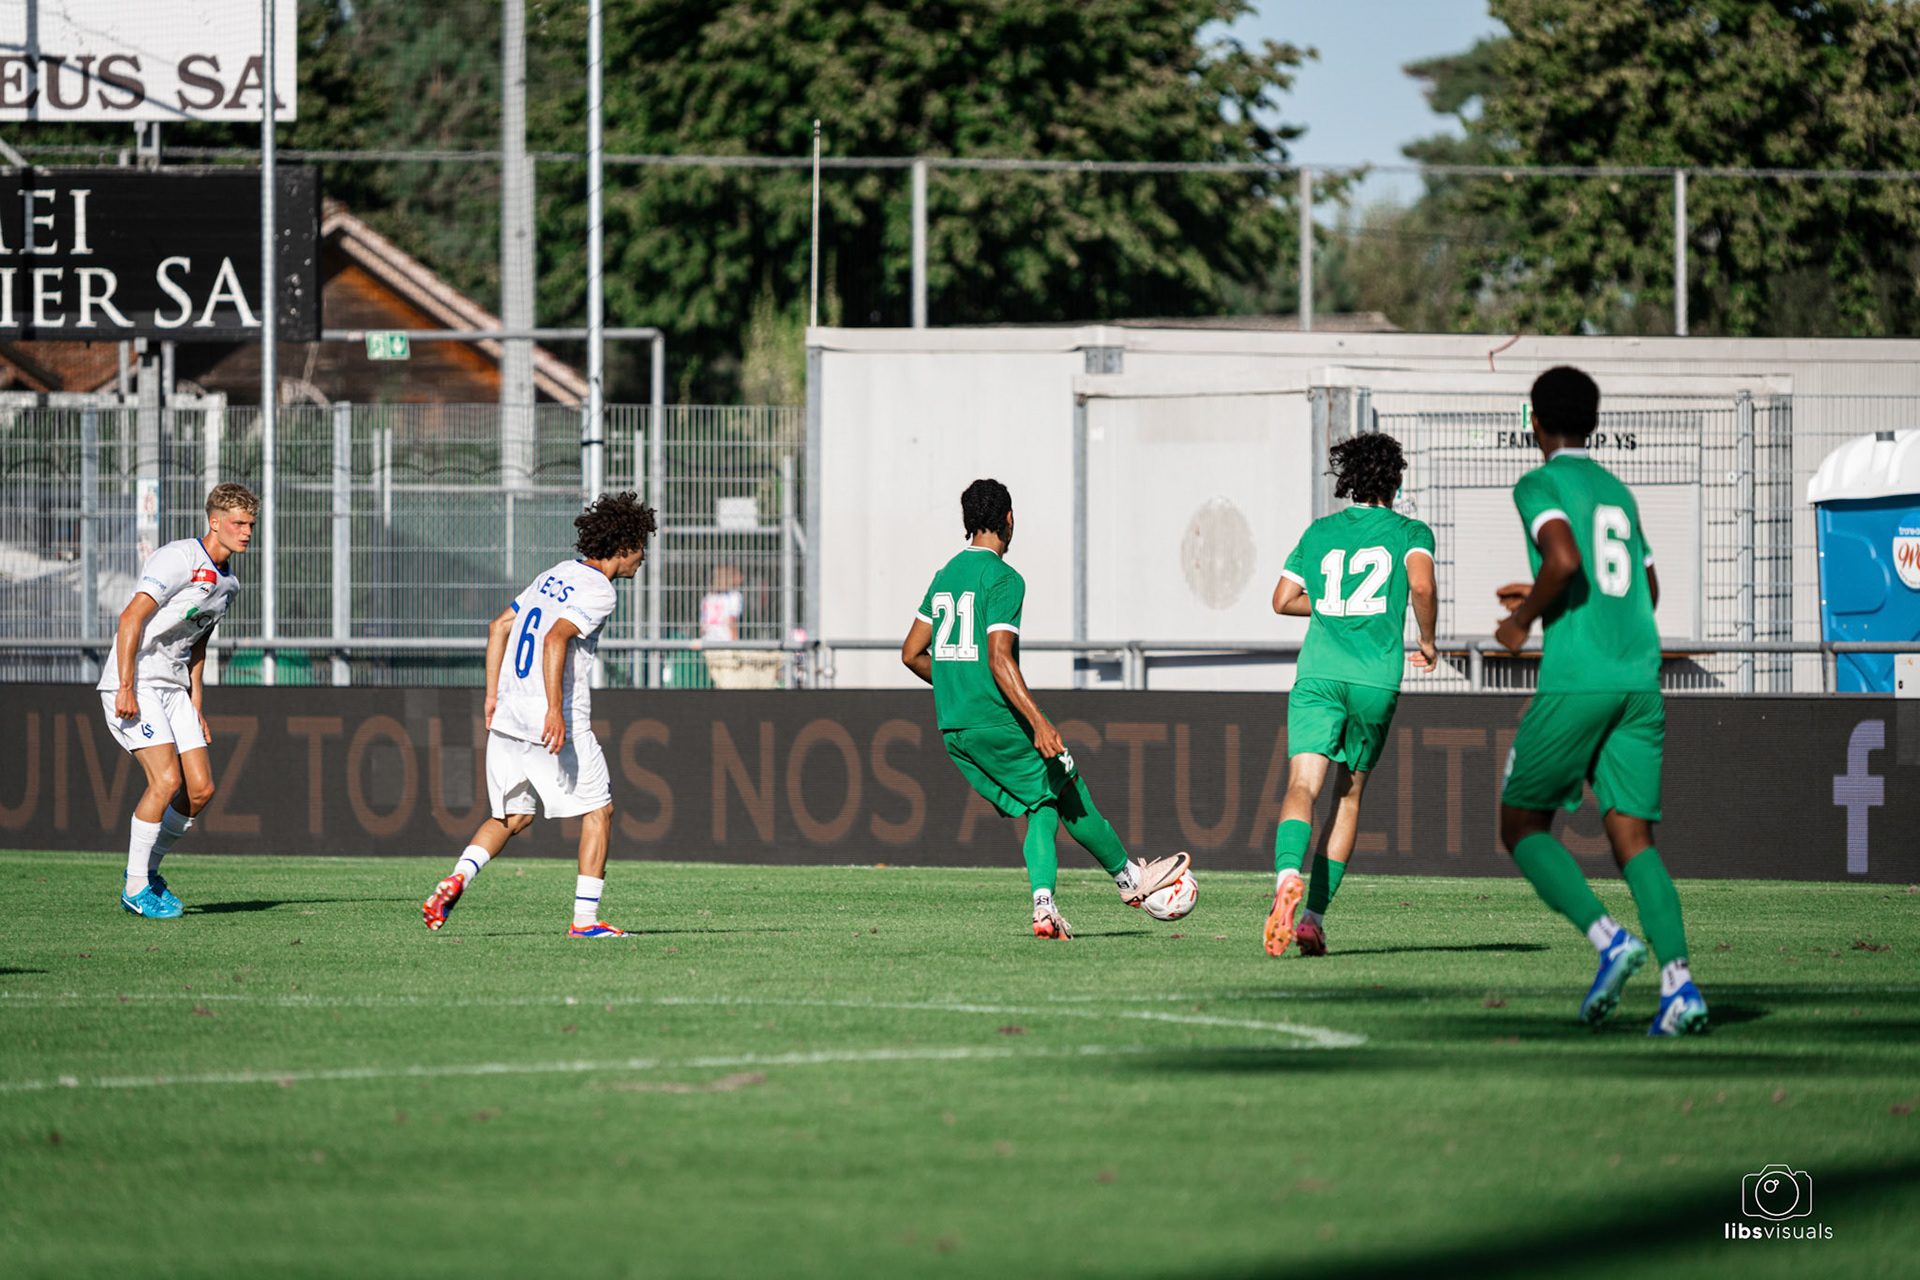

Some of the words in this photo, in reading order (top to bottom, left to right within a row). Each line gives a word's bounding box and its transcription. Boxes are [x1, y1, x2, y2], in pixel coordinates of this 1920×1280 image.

[176, 54, 286, 111] SA
[0, 188, 93, 254] EI
[154, 256, 262, 328] SA
[1315, 546, 1392, 616] 12
[1592, 503, 1632, 598] 6
[515, 606, 542, 679] 6
[932, 591, 979, 661] 21
[0, 712, 260, 832] UIVZ
[286, 714, 674, 841] TOUS
[711, 718, 927, 843] NOS
